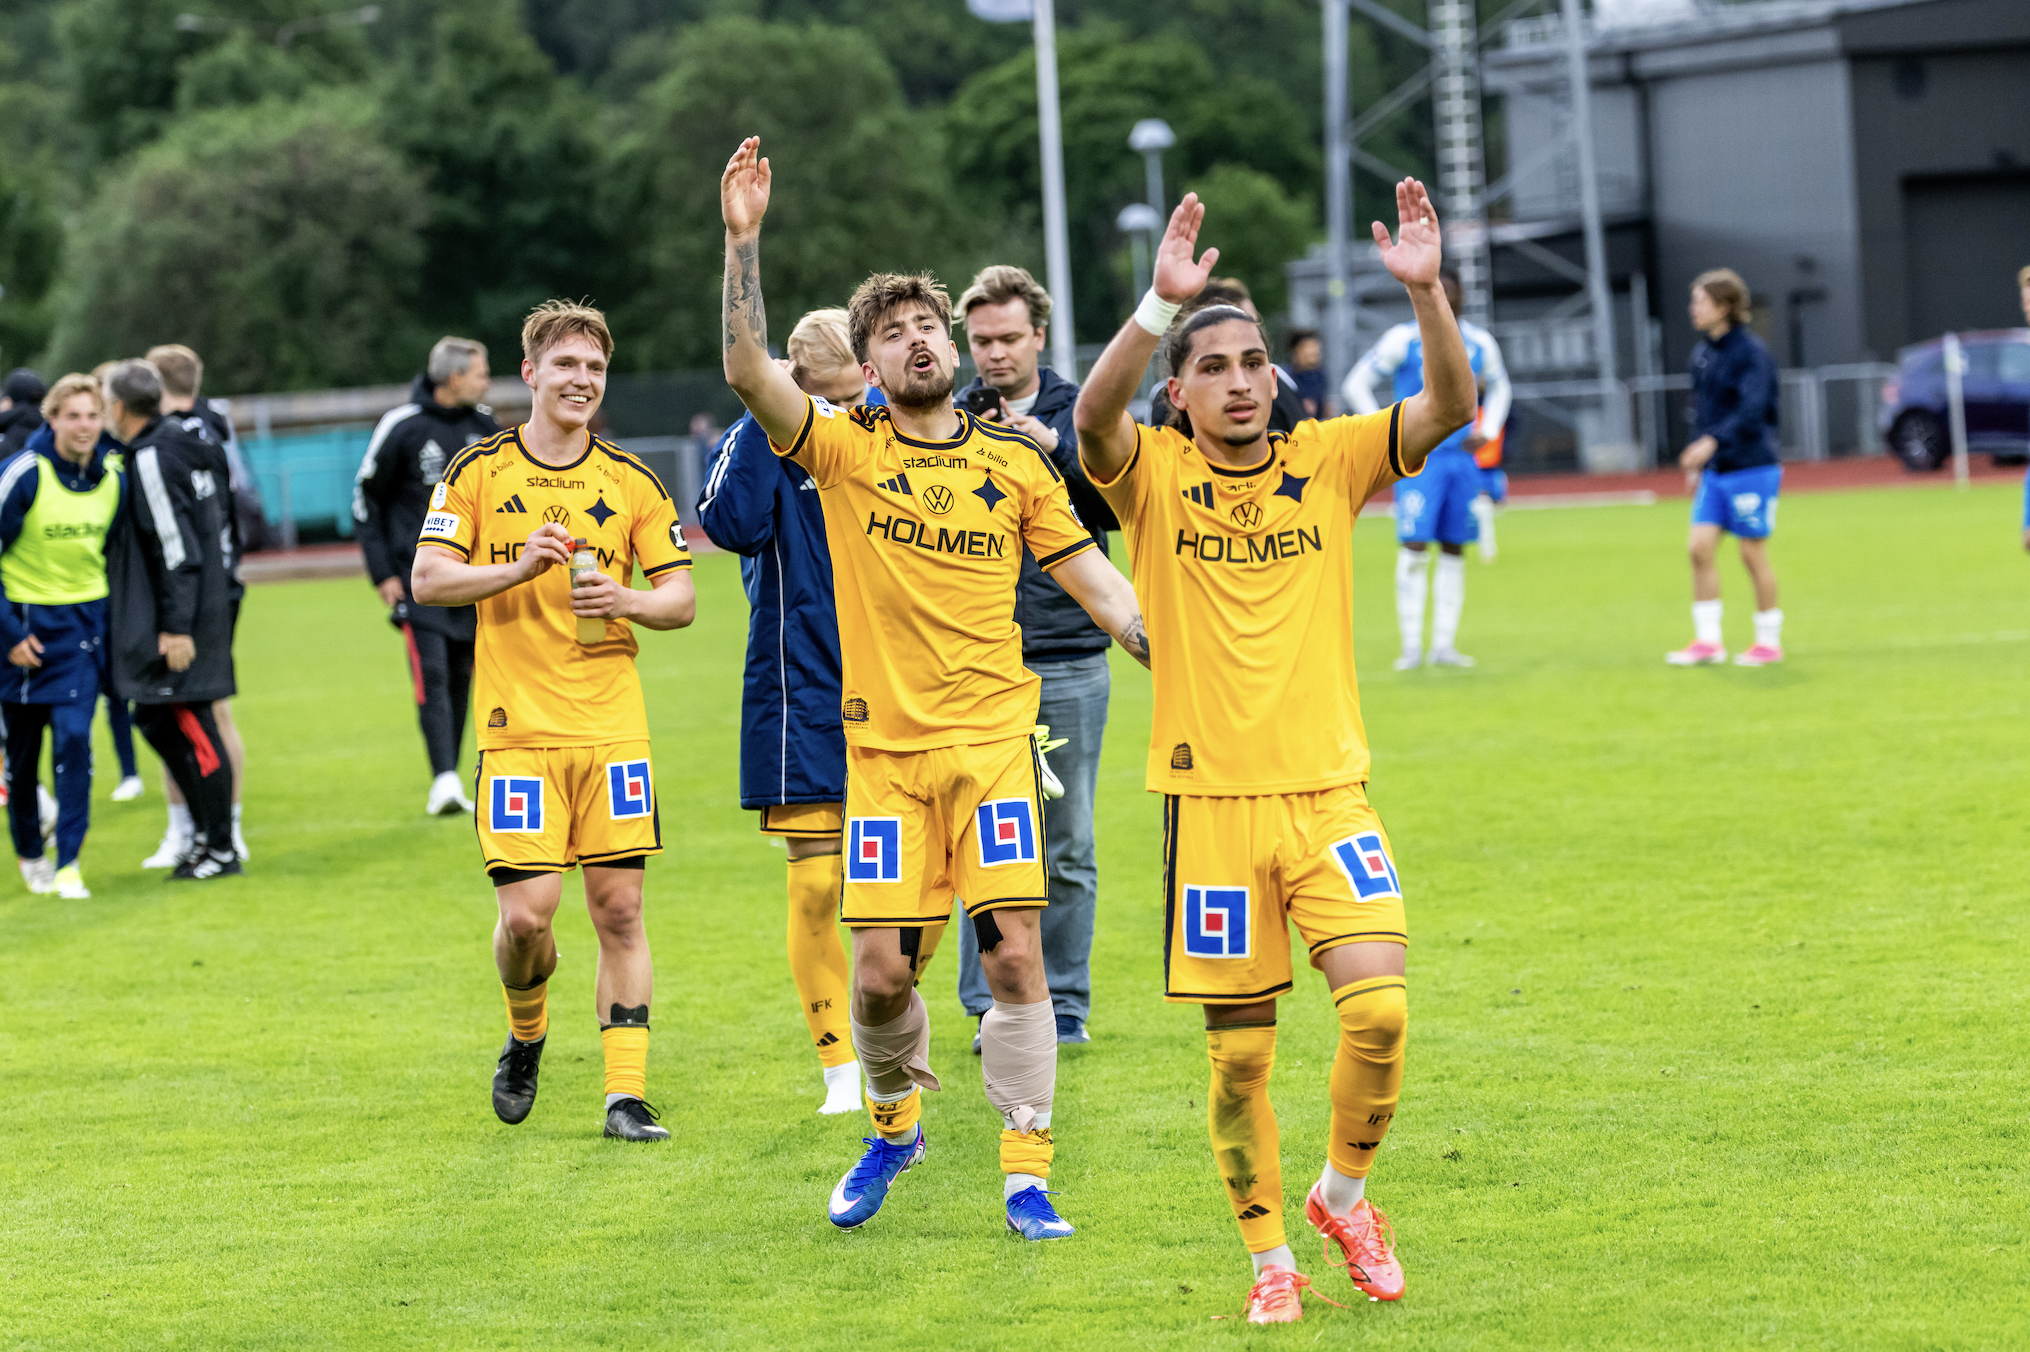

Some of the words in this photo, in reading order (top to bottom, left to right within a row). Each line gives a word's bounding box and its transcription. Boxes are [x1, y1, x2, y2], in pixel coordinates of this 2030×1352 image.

[496, 460, 515, 472] bilia
[902, 455, 968, 469] stadium
[986, 451, 1009, 468] bilia
[526, 476, 585, 490] stadium
[603, 469, 620, 485] bilia
[923, 485, 954, 515] VW
[1230, 501, 1263, 530] VW
[866, 511, 1005, 558] HOLMEN
[1176, 525, 1322, 563] HOLMEN
[811, 998, 833, 1014] IFK
[1227, 1173, 1258, 1189] IFK
